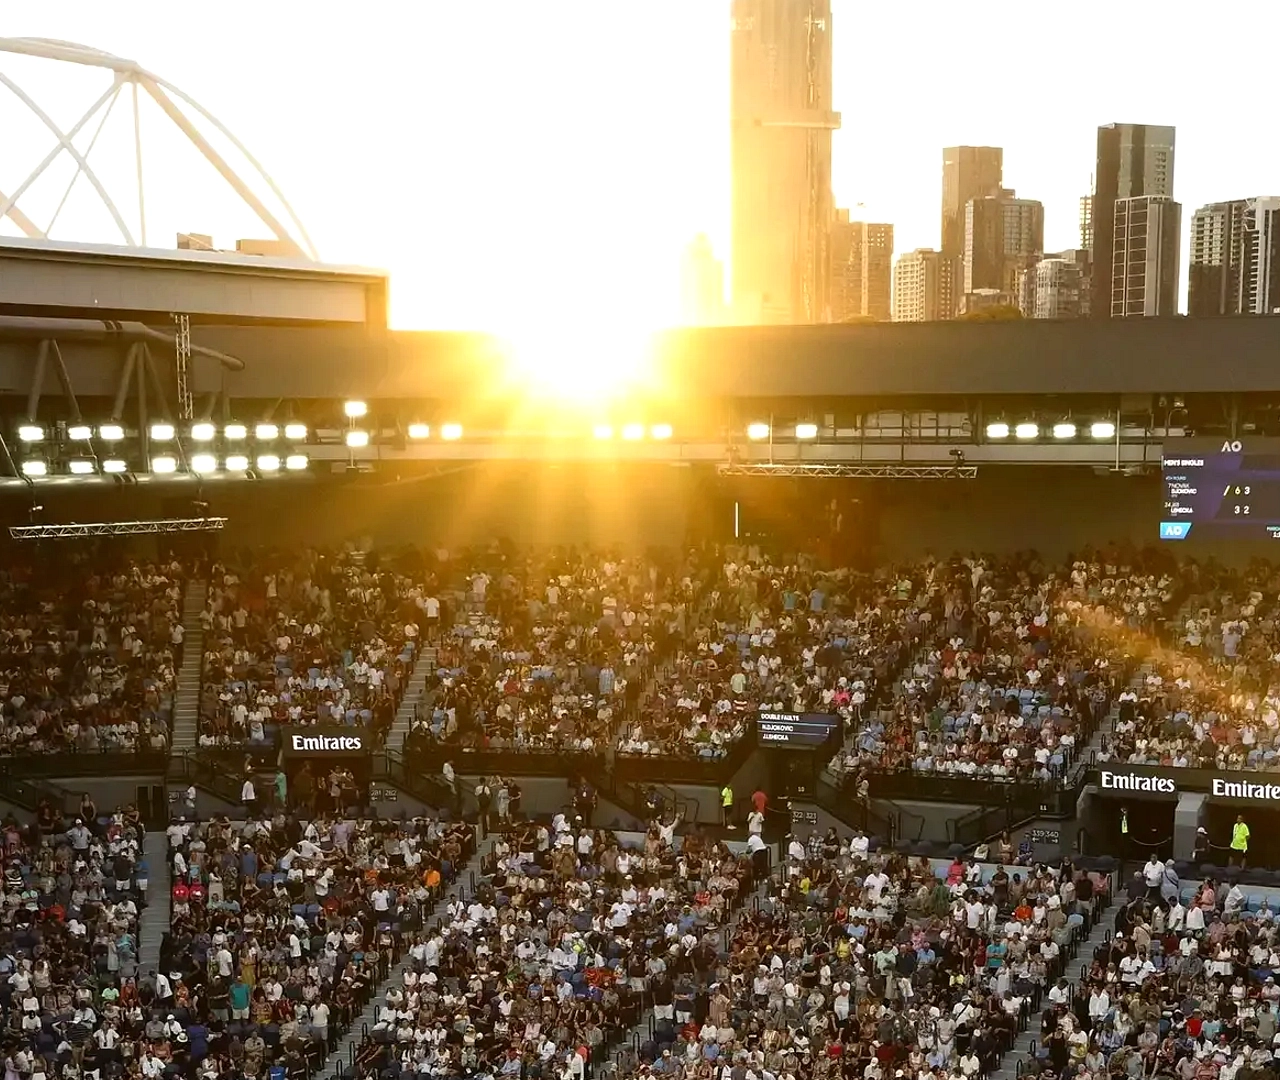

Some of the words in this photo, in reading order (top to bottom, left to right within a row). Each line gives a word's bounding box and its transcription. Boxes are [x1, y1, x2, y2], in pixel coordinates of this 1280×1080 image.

[1221, 440, 1243, 453] AO
[1234, 487, 1241, 495] 6
[1244, 487, 1251, 495] 3
[1234, 506, 1241, 514] 3
[1243, 506, 1250, 514] 2
[291, 734, 363, 751] Emirates
[1101, 771, 1176, 793] Emirates
